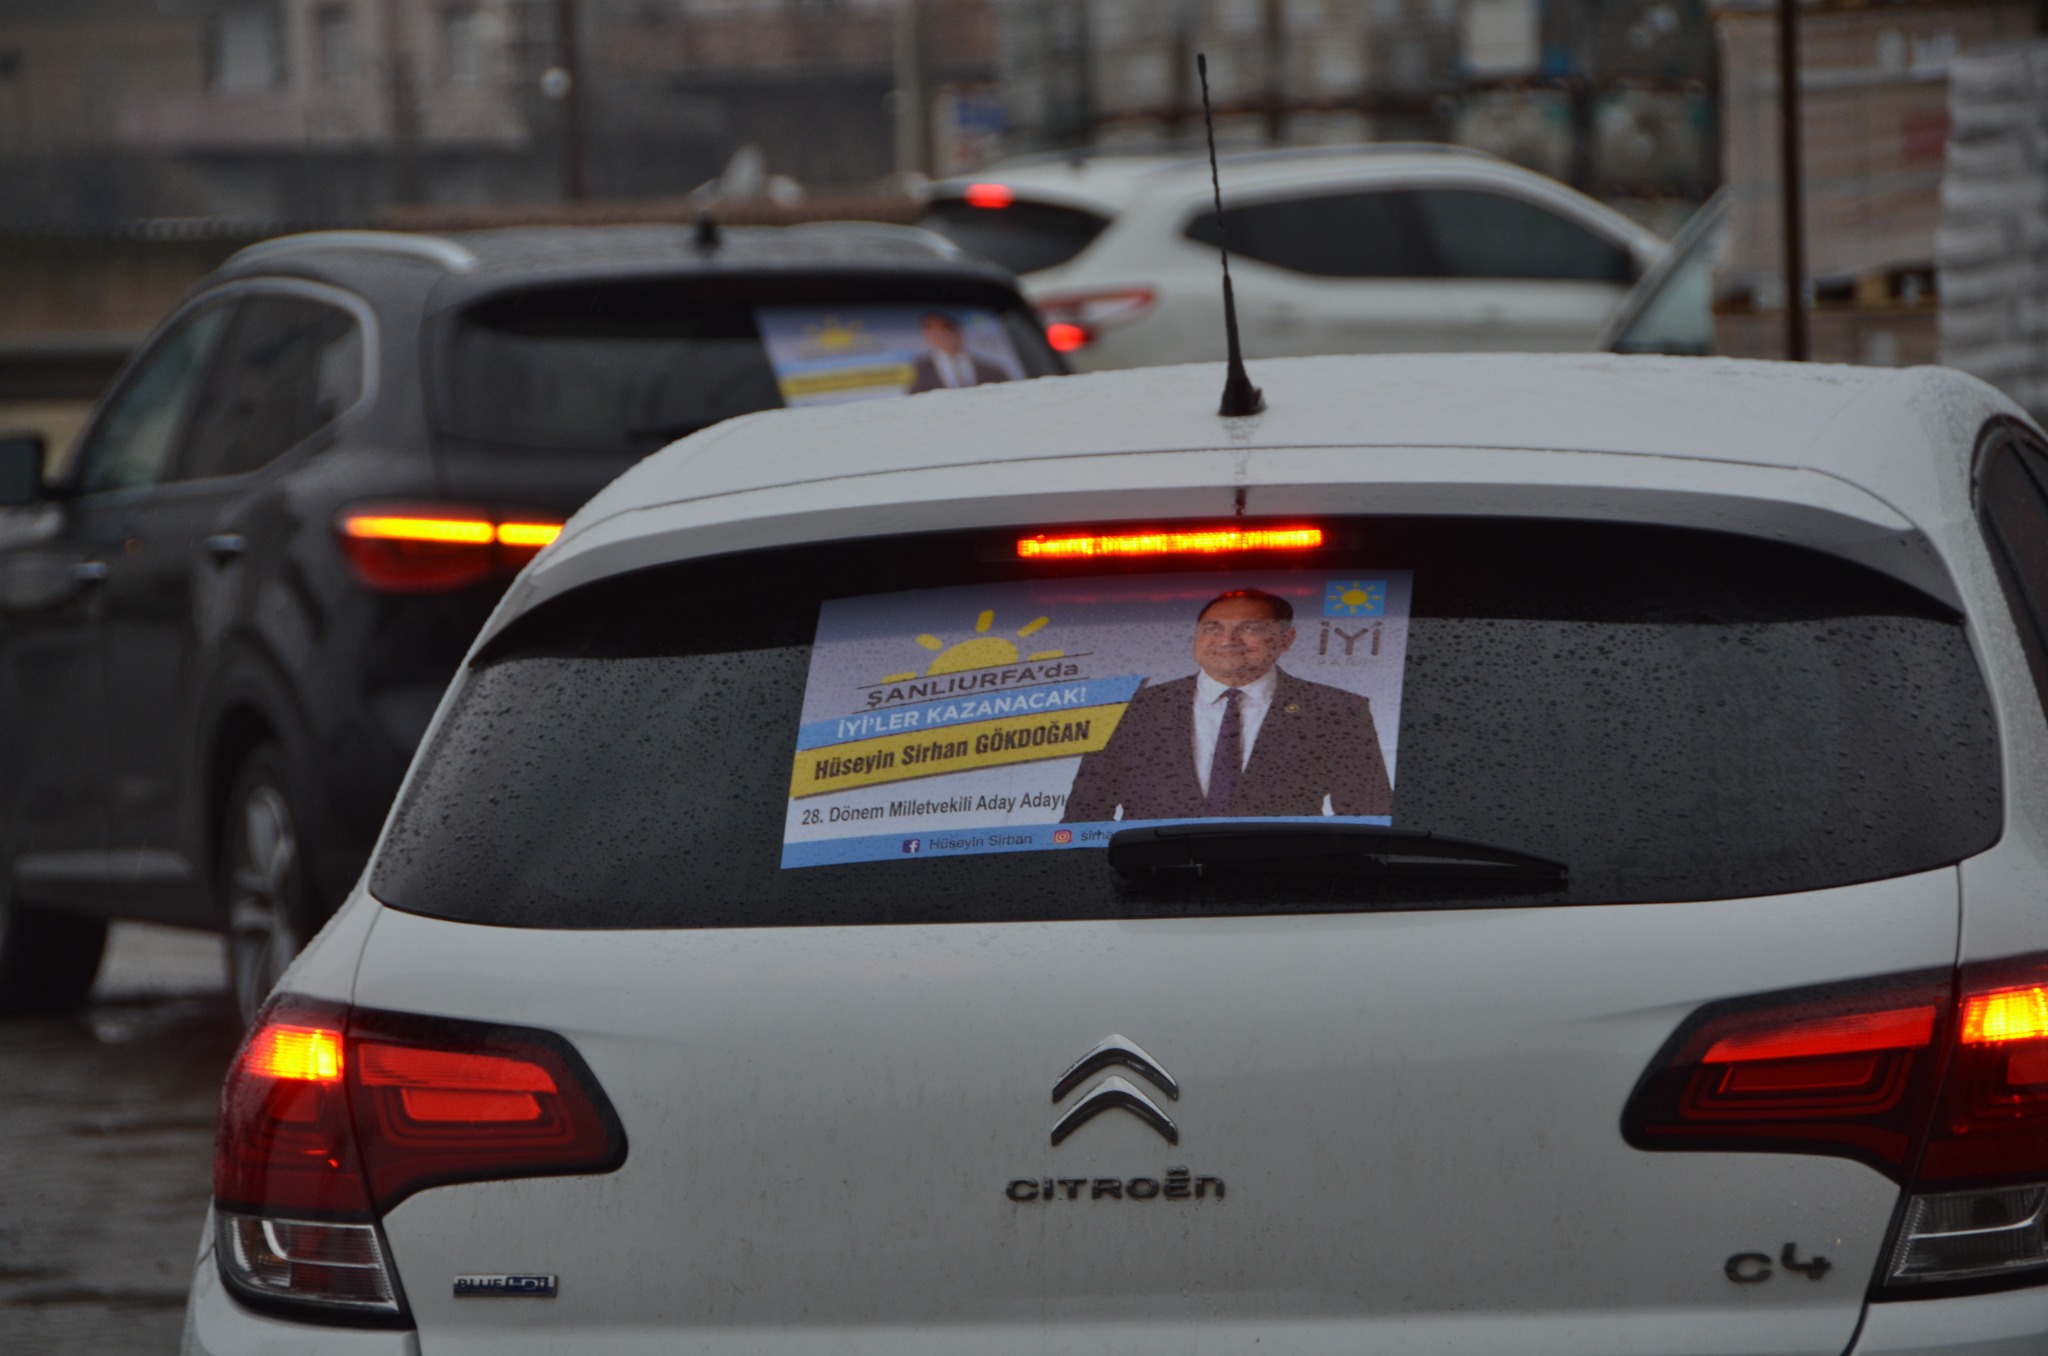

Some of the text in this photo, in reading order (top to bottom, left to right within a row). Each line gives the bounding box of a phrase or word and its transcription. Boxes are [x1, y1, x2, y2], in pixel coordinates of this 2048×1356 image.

[866, 662, 1080, 708] ŞANLIURFA'da
[837, 686, 1088, 738] İYİ'LER KAZANACAK!
[814, 719, 1092, 781] Hüseyin Sirhan GÖKDOĞAN
[801, 791, 1066, 826] 28. Dönem Milletvekili Aday Adayı
[928, 833, 1033, 852] Hüseyin Sirhan
[1723, 1241, 1833, 1285] C4
